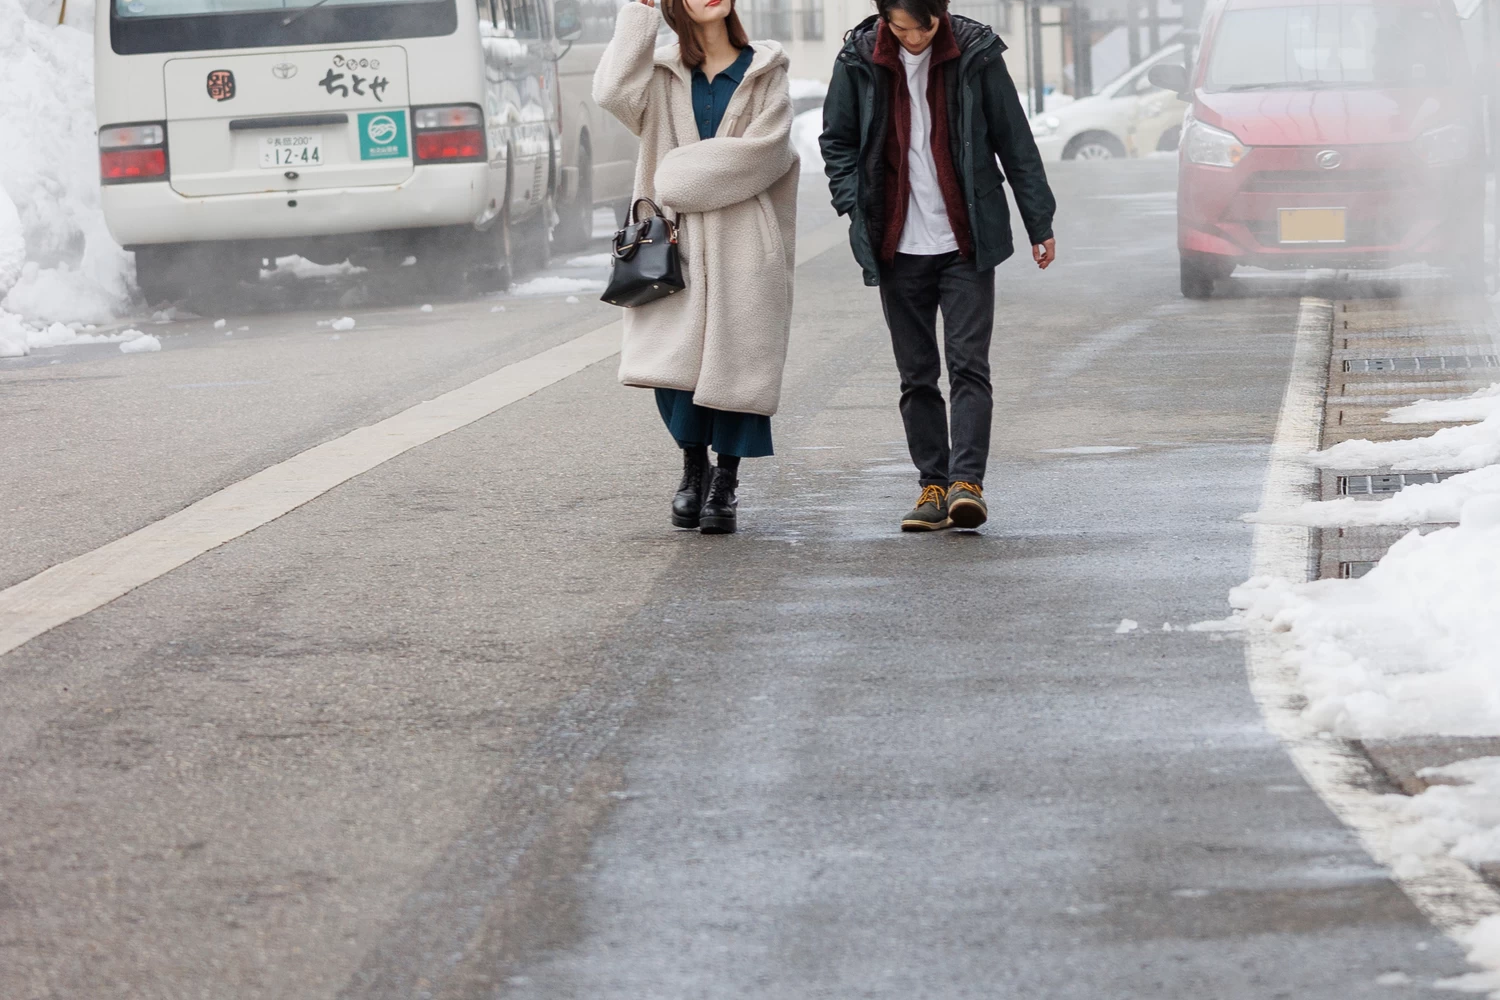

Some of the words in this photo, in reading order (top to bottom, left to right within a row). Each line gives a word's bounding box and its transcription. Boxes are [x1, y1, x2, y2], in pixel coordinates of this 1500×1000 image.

[318, 68, 390, 103] ちとせ
[275, 146, 320, 165] 12-44
